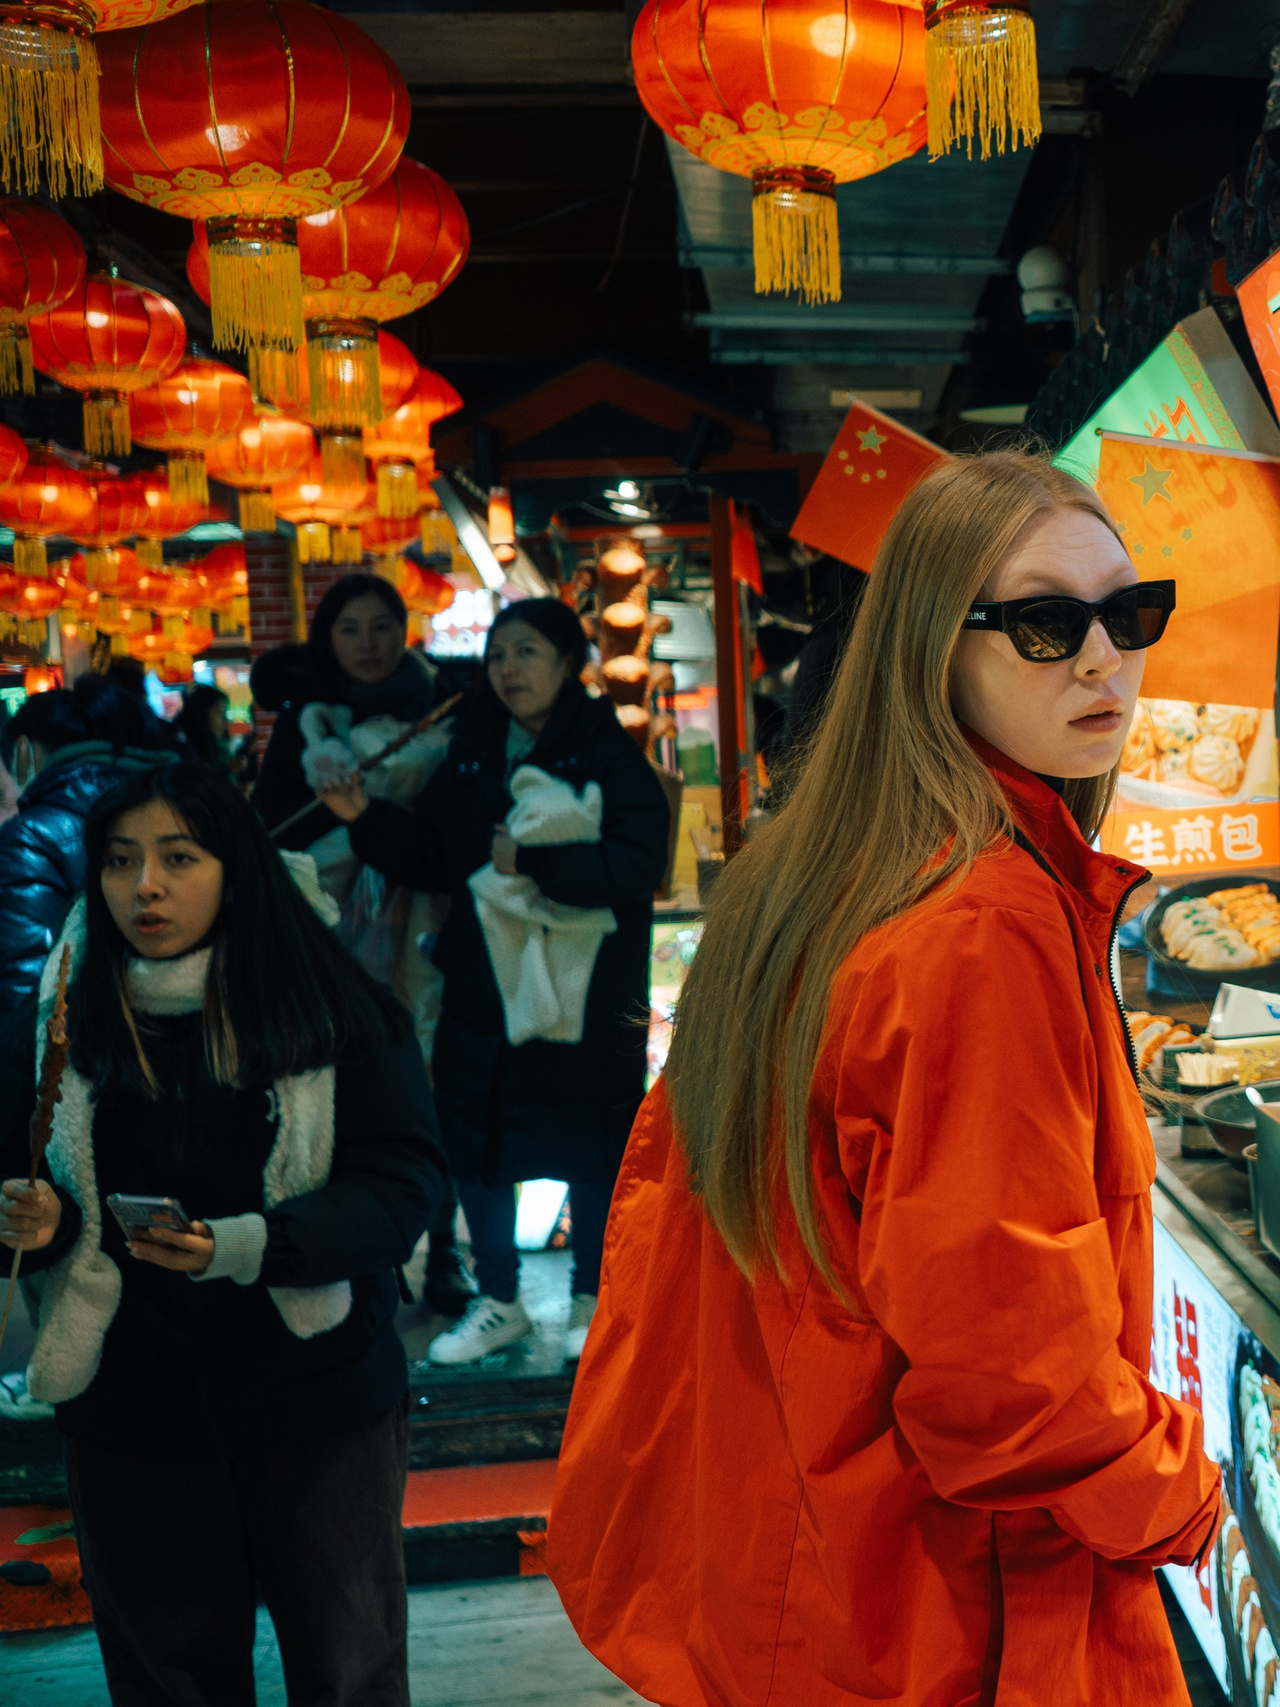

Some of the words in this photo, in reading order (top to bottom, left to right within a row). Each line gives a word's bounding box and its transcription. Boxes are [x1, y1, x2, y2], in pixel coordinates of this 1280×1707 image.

[966, 611, 987, 621] ELINE
[1123, 813, 1263, 867] 生煎包
